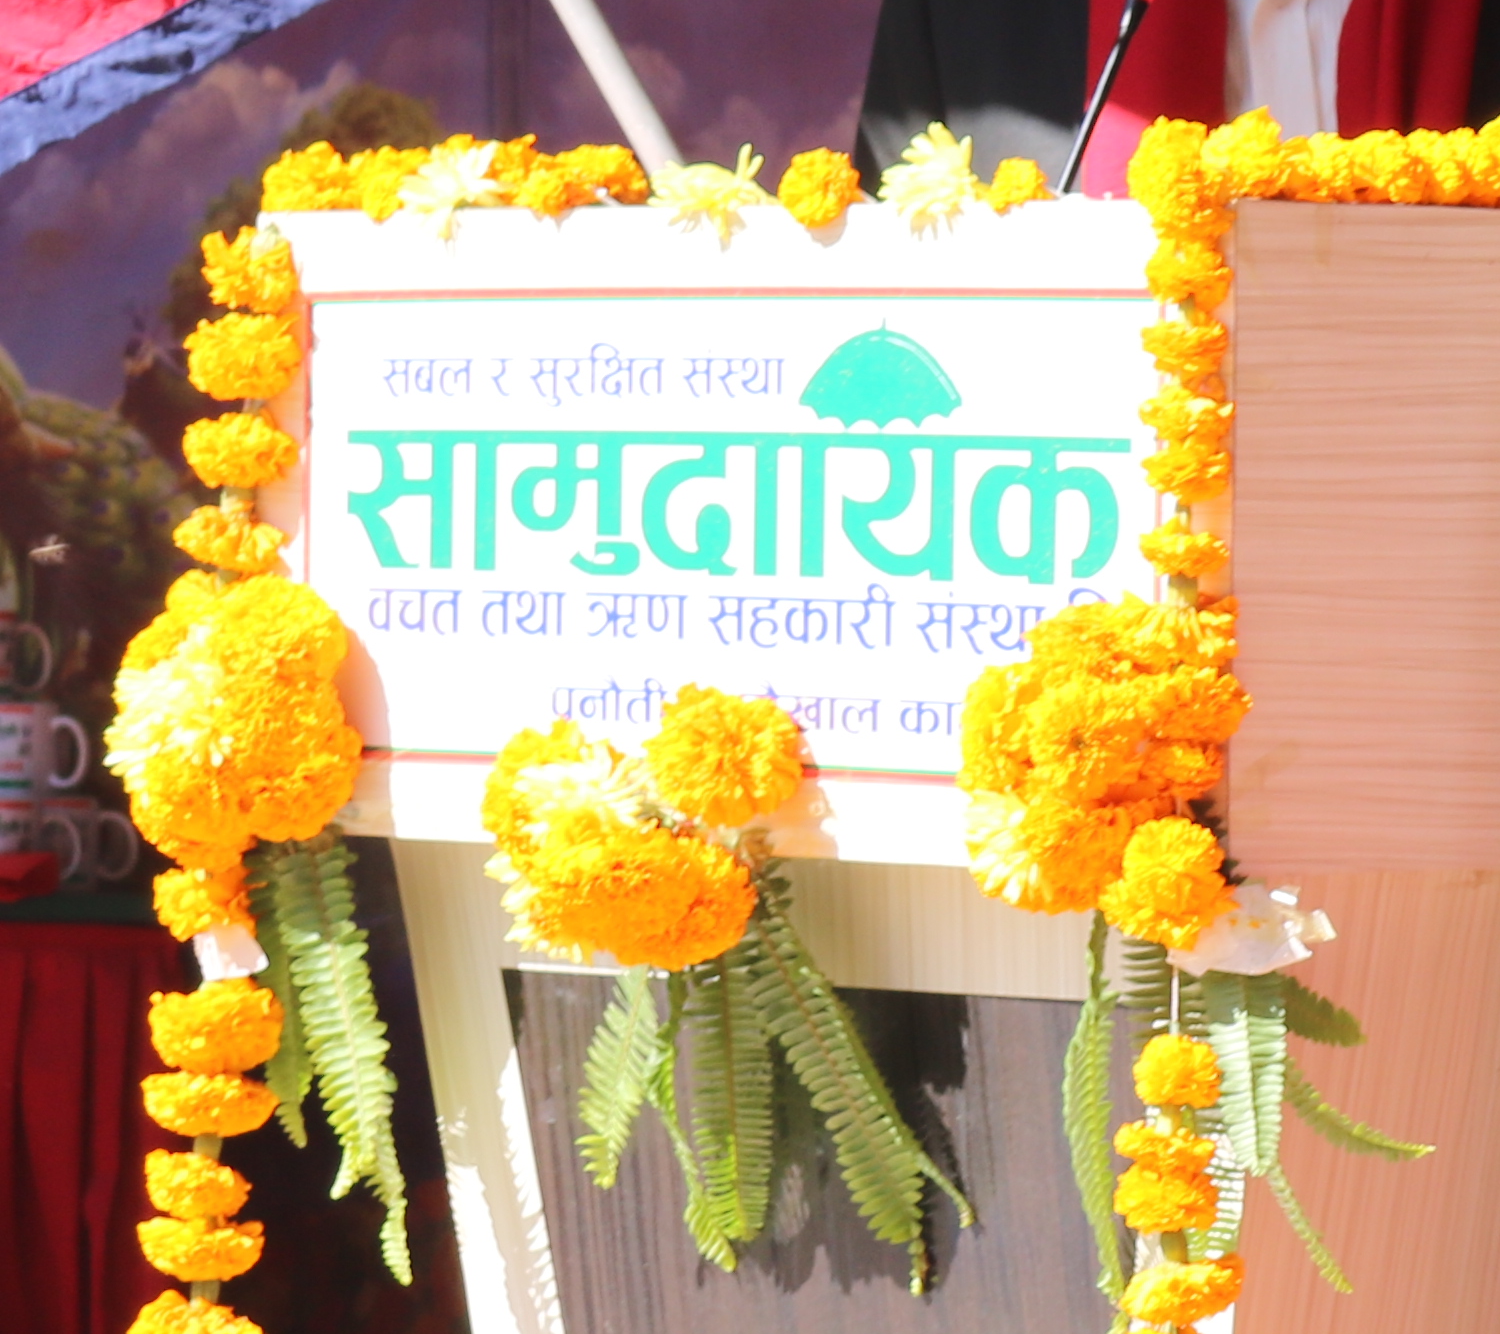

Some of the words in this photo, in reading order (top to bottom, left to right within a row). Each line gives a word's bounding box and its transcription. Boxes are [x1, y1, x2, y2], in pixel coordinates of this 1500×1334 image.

[383, 356, 473, 398] सबल
[490, 356, 515, 398] र
[529, 342, 666, 408] सुरक्षित
[683, 349, 785, 399] संस्था
[347, 429, 1132, 585] सामुदायिक
[481, 589, 567, 638] तथा
[586, 590, 688, 641] ऋण
[708, 582, 895, 649] सहकारी
